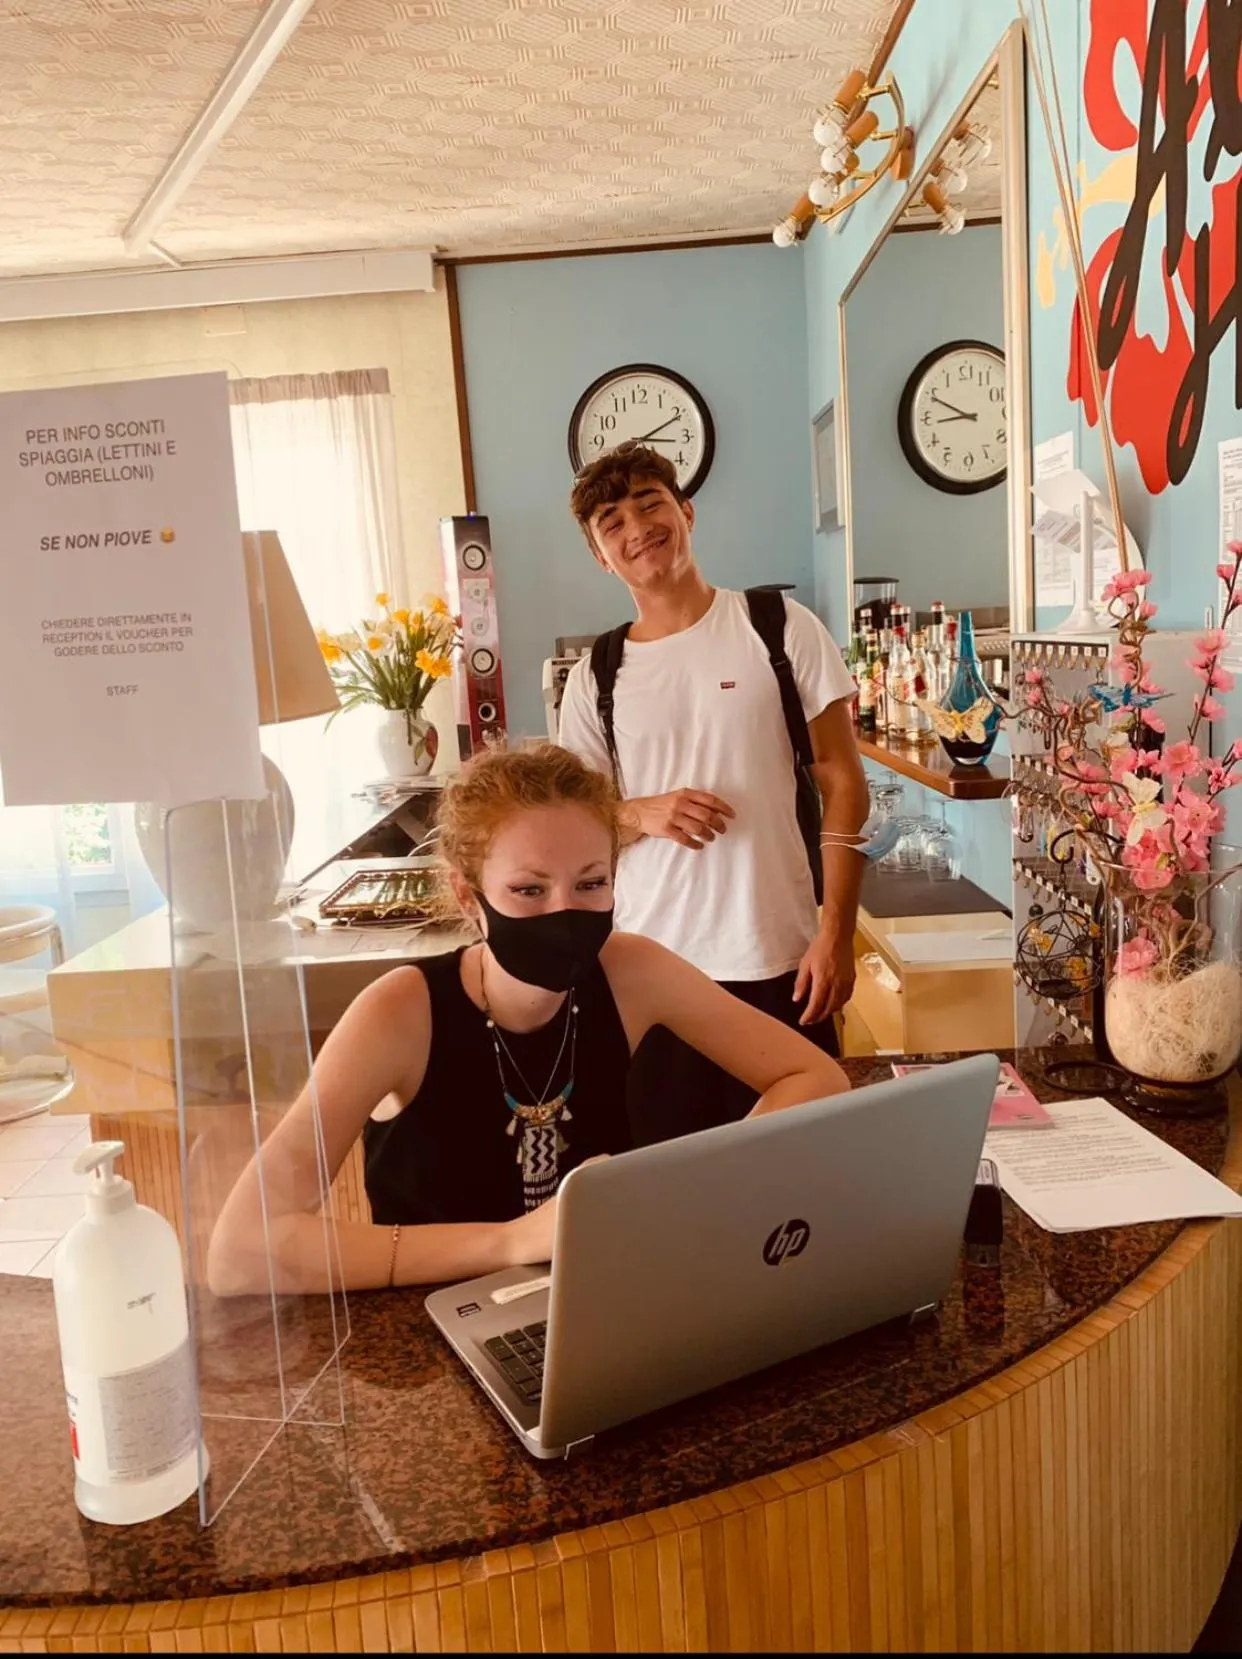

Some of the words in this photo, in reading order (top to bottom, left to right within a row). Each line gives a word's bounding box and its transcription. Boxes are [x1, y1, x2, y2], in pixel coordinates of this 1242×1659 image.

[631, 388, 648, 404] 12
[657, 393, 663, 409] 1
[613, 397, 627, 412] 11
[671, 406, 682, 421] 2
[600, 415, 616, 431] 10
[25, 428, 58, 444] PER
[63, 424, 100, 441] INFO
[105, 419, 165, 438] SCONTI
[681, 429, 691, 444] 3
[593, 435, 605, 451] 9
[18, 448, 94, 467] SPIAGGIA
[97, 442, 162, 464] (LETTINI
[166, 440, 177, 455] E
[674, 451, 684, 466] 4
[45, 464, 154, 486] OMBRELLONI)
[40, 536, 61, 551] SE
[65, 533, 100, 549] NON
[104, 530, 152, 547] PIOVE
[41, 617, 95, 630] CHIEDERE
[97, 612, 177, 627] DIRETTAMENTE
[180, 612, 192, 623] IN
[42, 631, 103, 644] RECEPTION
[105, 629, 114, 641] IL
[116, 628, 168, 641] VOUCHER
[171, 626, 193, 637] PER
[54, 645, 99, 657] GODERE
[102, 643, 136, 655] DELLO
[139, 641, 184, 653] SCONTO
[106, 684, 138, 696] STAFF
[766, 1219, 807, 1267] hp
